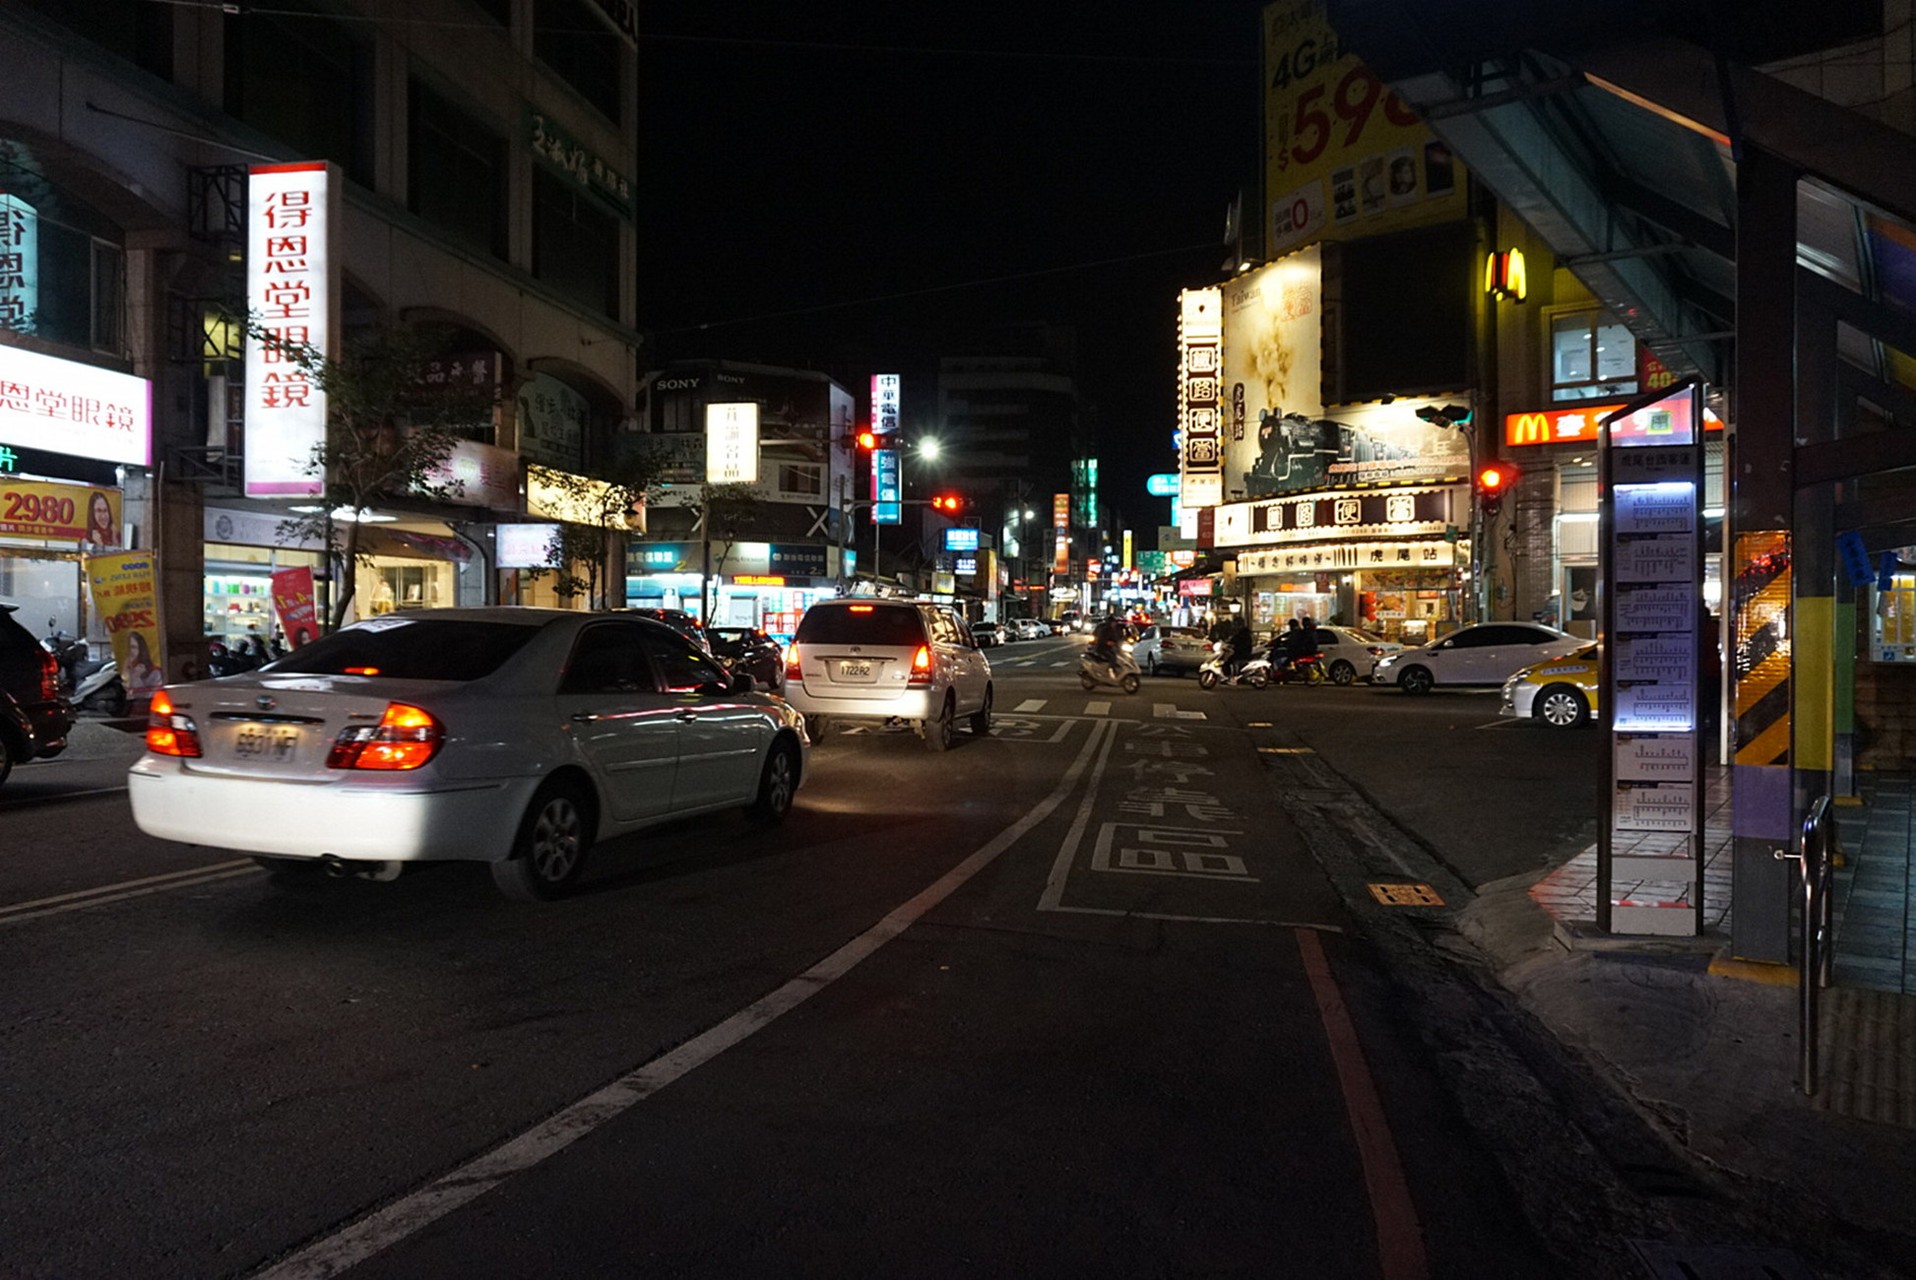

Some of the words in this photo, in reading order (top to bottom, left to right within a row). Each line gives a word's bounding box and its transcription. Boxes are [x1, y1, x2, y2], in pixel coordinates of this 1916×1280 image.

[1272, 39, 1317, 89] 4G
[261, 190, 312, 408] 得恩堂眼鏡
[656, 378, 700, 391] SONY
[717, 374, 745, 384] SONY
[880, 375, 897, 428] 中華電信
[880, 449, 897, 501] 強電信
[4, 491, 74, 525] 2980
[1370, 546, 1438, 563] 虎尾站
